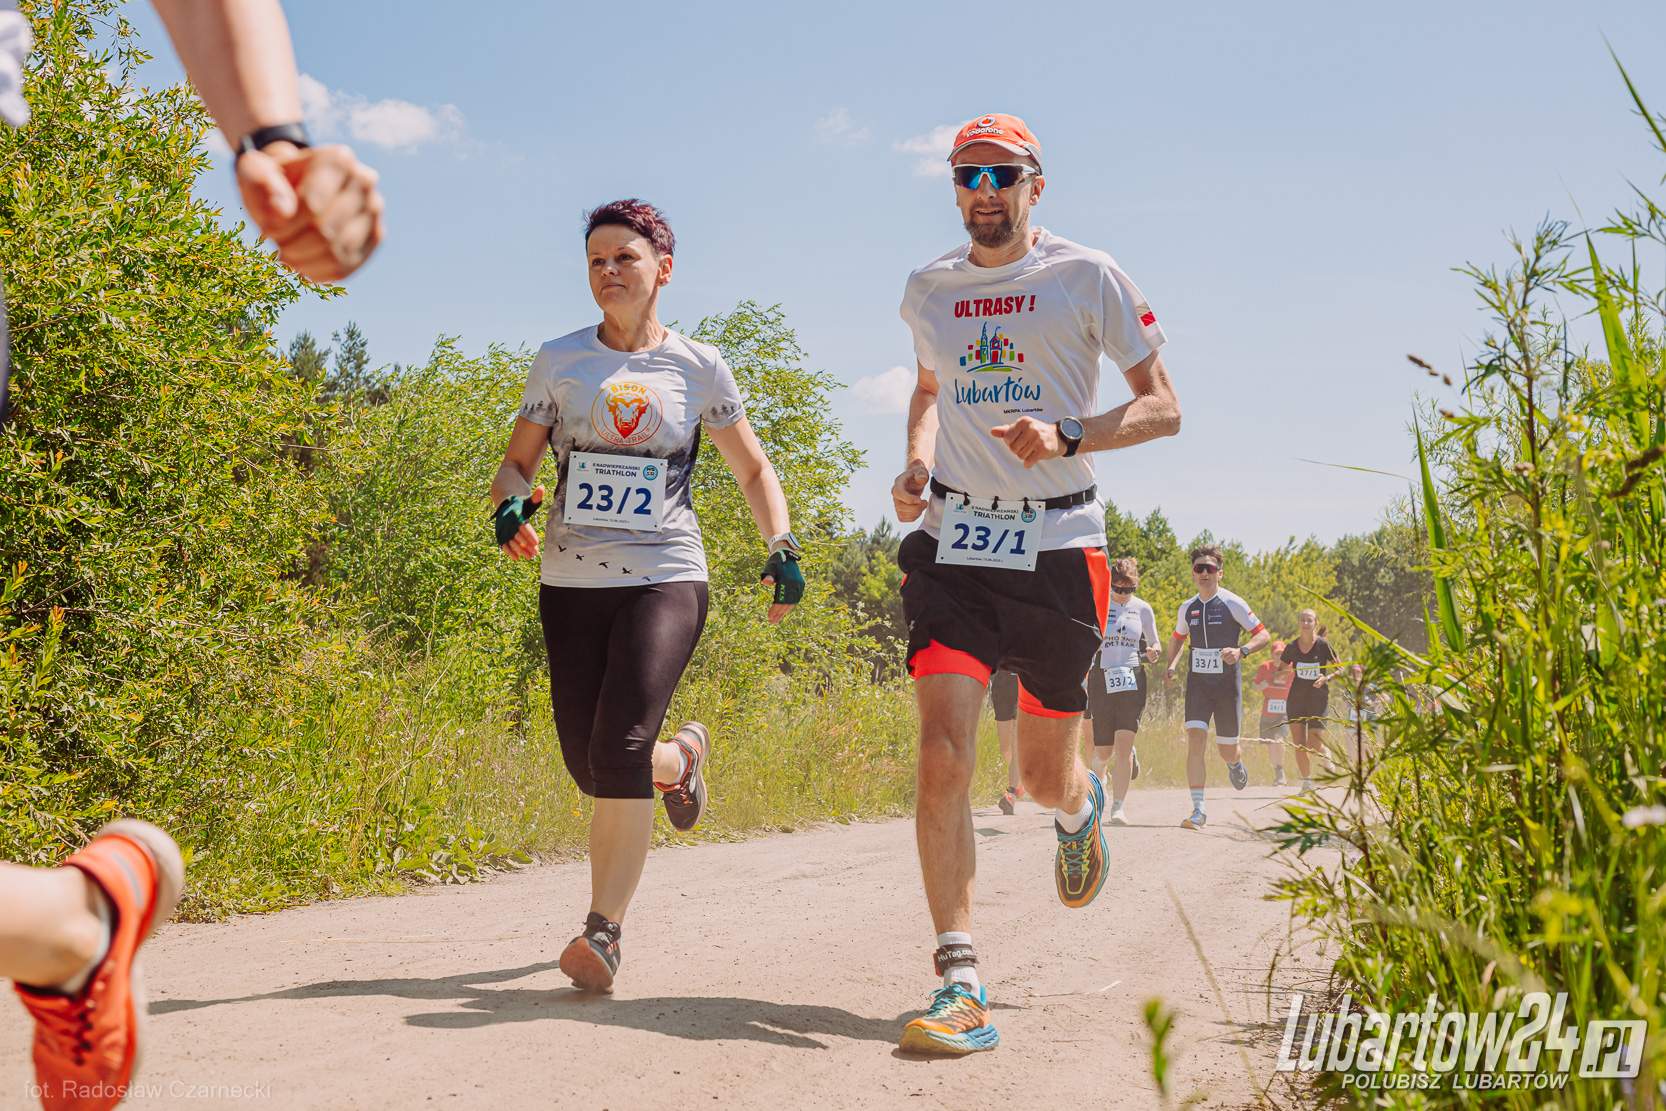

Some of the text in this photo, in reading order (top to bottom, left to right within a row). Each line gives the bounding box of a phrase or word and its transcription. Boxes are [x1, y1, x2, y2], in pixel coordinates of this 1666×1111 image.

[954, 295, 1025, 318] ULTRASY
[611, 384, 646, 394] BISON
[954, 376, 1041, 405] Lubartów
[595, 468, 637, 477] TRIATHLON
[576, 482, 652, 515] 23/2
[973, 510, 1015, 520] TRIATHLON
[951, 523, 1026, 555] 23/1
[1195, 658, 1219, 669] 33/1
[1109, 676, 1133, 687] 33/2
